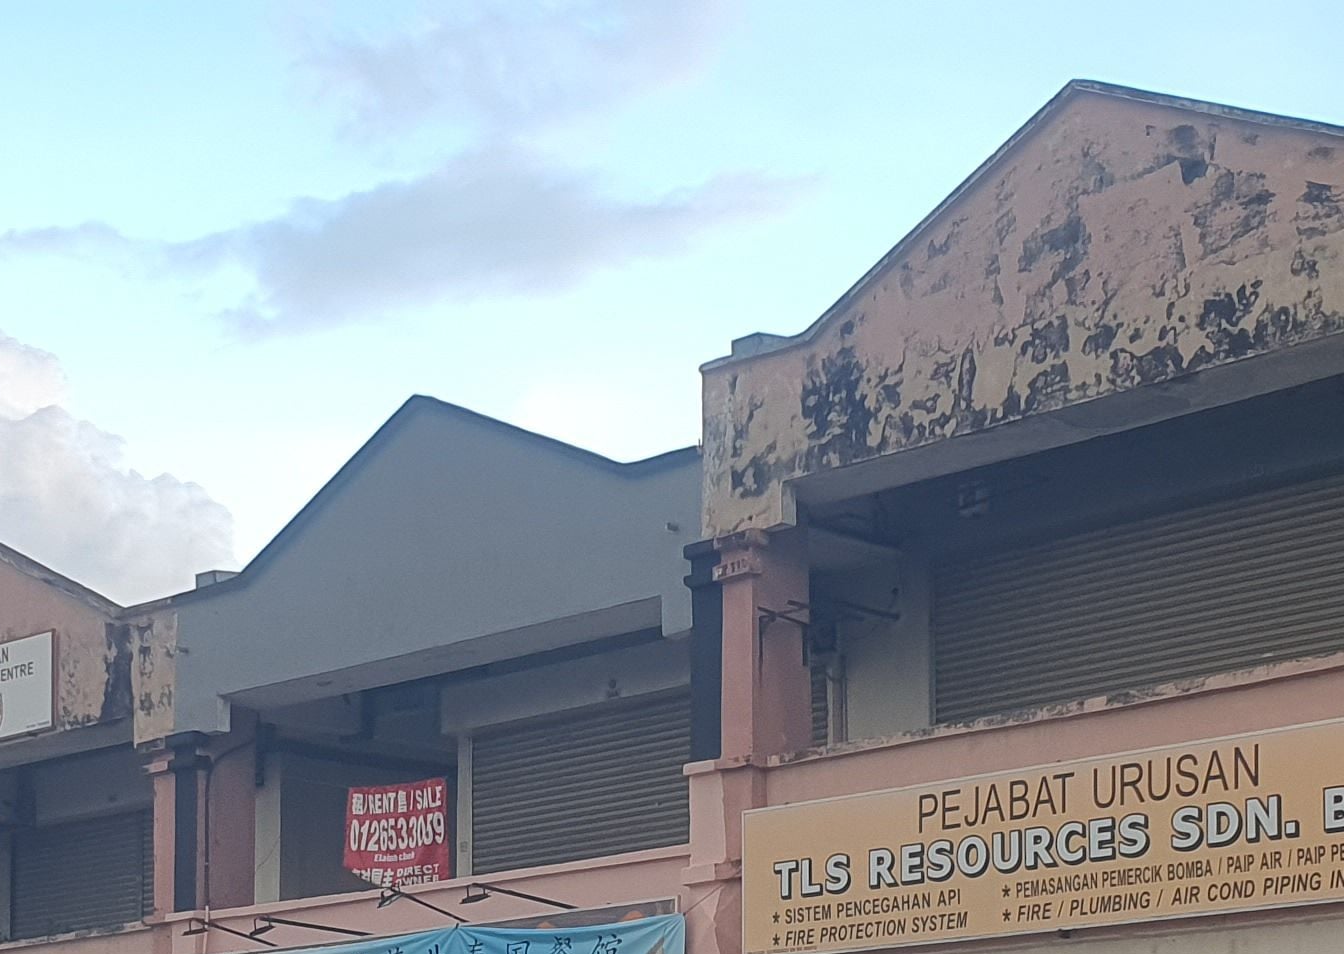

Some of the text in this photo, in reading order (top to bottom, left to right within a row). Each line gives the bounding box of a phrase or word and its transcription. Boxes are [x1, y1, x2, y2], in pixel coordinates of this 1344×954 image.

[917, 743, 1260, 834] PEJABAT URUSAN
[350, 811, 445, 852] 0126533059
[773, 853, 852, 900] TLS
[867, 811, 1151, 890] RESOURCES
[1170, 793, 1301, 852] SDN.
[396, 863, 440, 877] DIRECT
[1015, 875, 1098, 899] PEMASANGAN
[1100, 864, 1163, 891] PEMERCIK
[1167, 861, 1213, 882] BOMBA
[1226, 855, 1255, 874] PAIP
[1259, 851, 1282, 870] AIR
[1296, 844, 1326, 865] PAIP
[784, 888, 962, 925] SISTEM PENCEGAHAN API
[1016, 901, 1052, 923] FIRE
[1068, 890, 1151, 918] PLUMBING
[1171, 884, 1201, 906] AIR
[1207, 879, 1256, 902] COND
[1262, 871, 1323, 897] PIPING
[784, 910, 968, 947] FIRE PROTECTION SYSTEM
